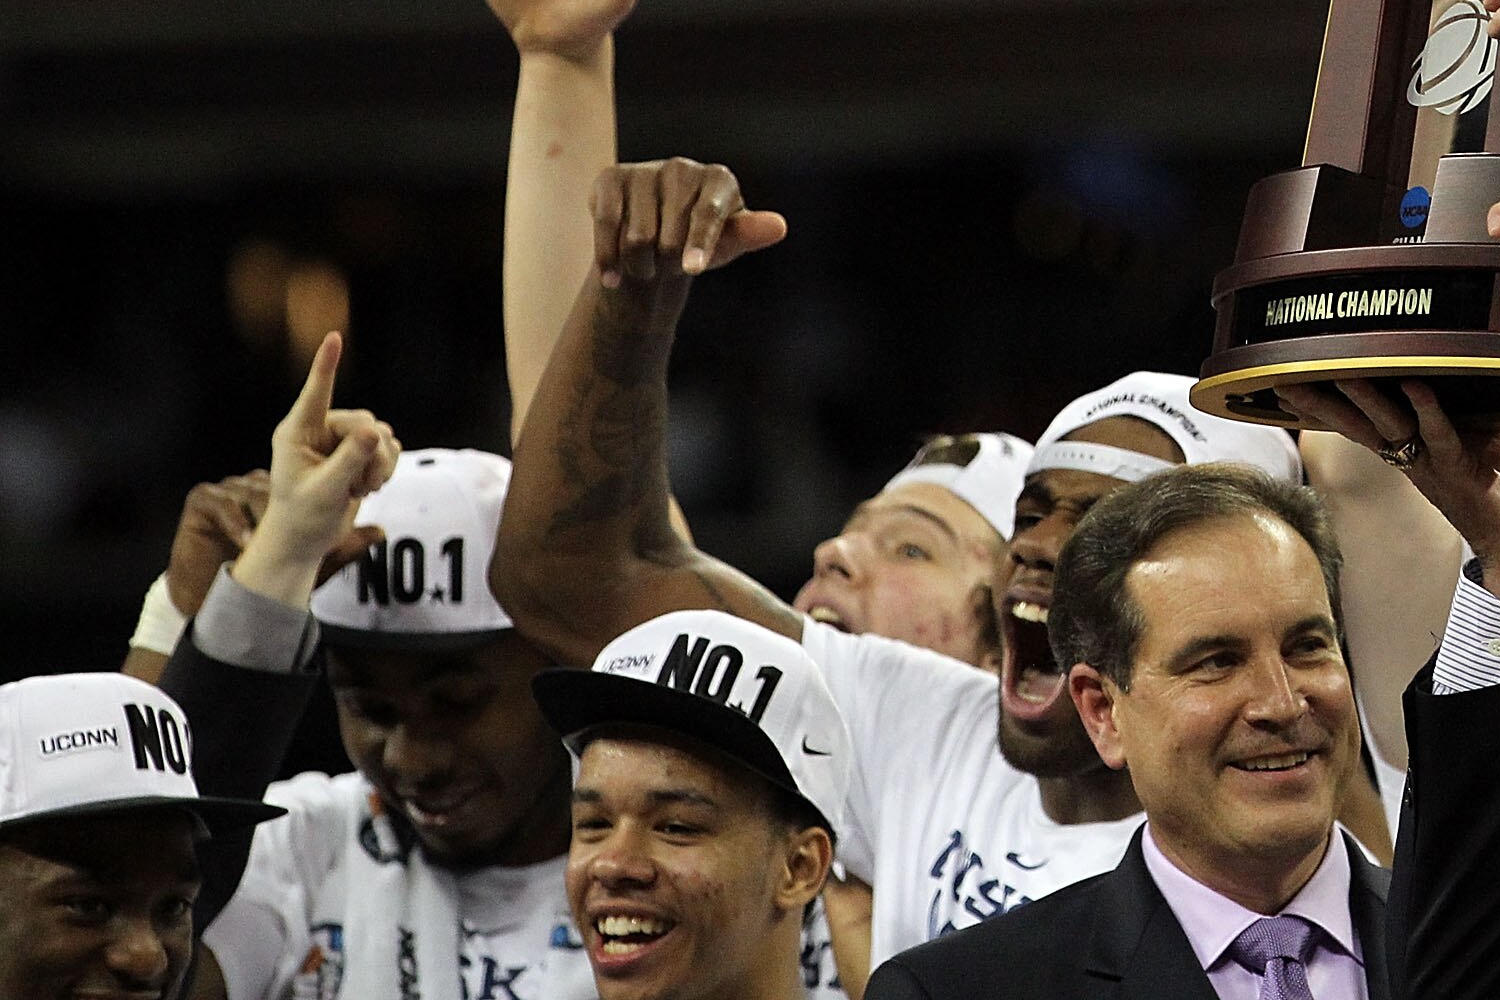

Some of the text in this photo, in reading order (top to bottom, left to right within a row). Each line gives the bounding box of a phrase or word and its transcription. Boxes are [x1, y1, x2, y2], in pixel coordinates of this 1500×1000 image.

[1265, 288, 1433, 327] NATIONAL CHAMPION
[40, 727, 119, 755] UCONN
